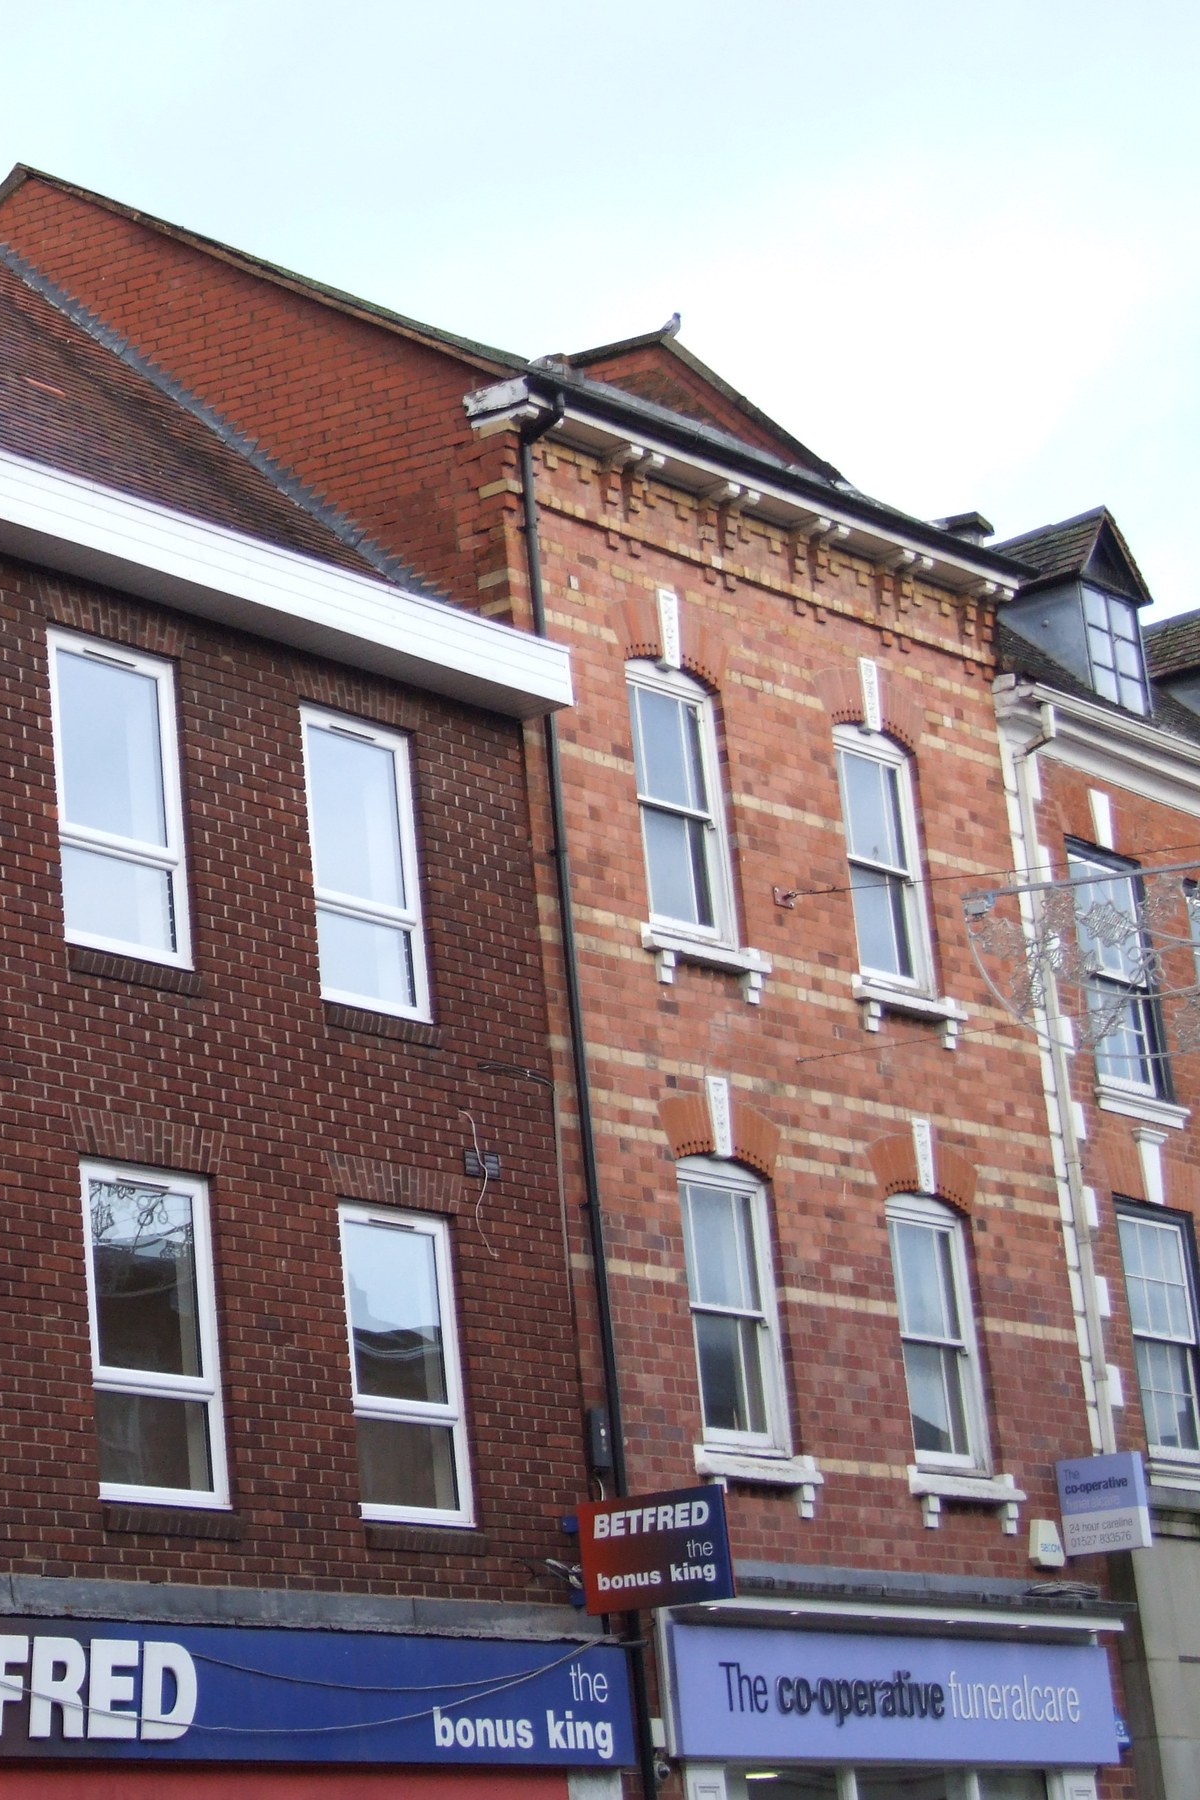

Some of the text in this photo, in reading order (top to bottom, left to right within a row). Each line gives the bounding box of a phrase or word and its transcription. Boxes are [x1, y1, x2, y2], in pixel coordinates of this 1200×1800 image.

[1064, 1469, 1079, 1481] The
[1065, 1476, 1128, 1495] co-operative
[593, 1500, 709, 1539] BETFRED
[1069, 1517, 1133, 1534] 24 hour careline
[686, 1540, 713, 1558] the
[1071, 1535, 1097, 1548] 01527
[597, 1562, 716, 1591] bonus king
[569, 1663, 608, 1703] the
[718, 1661, 1081, 1727] The co-operative funeralcare
[432, 1706, 613, 1759] bonus king
